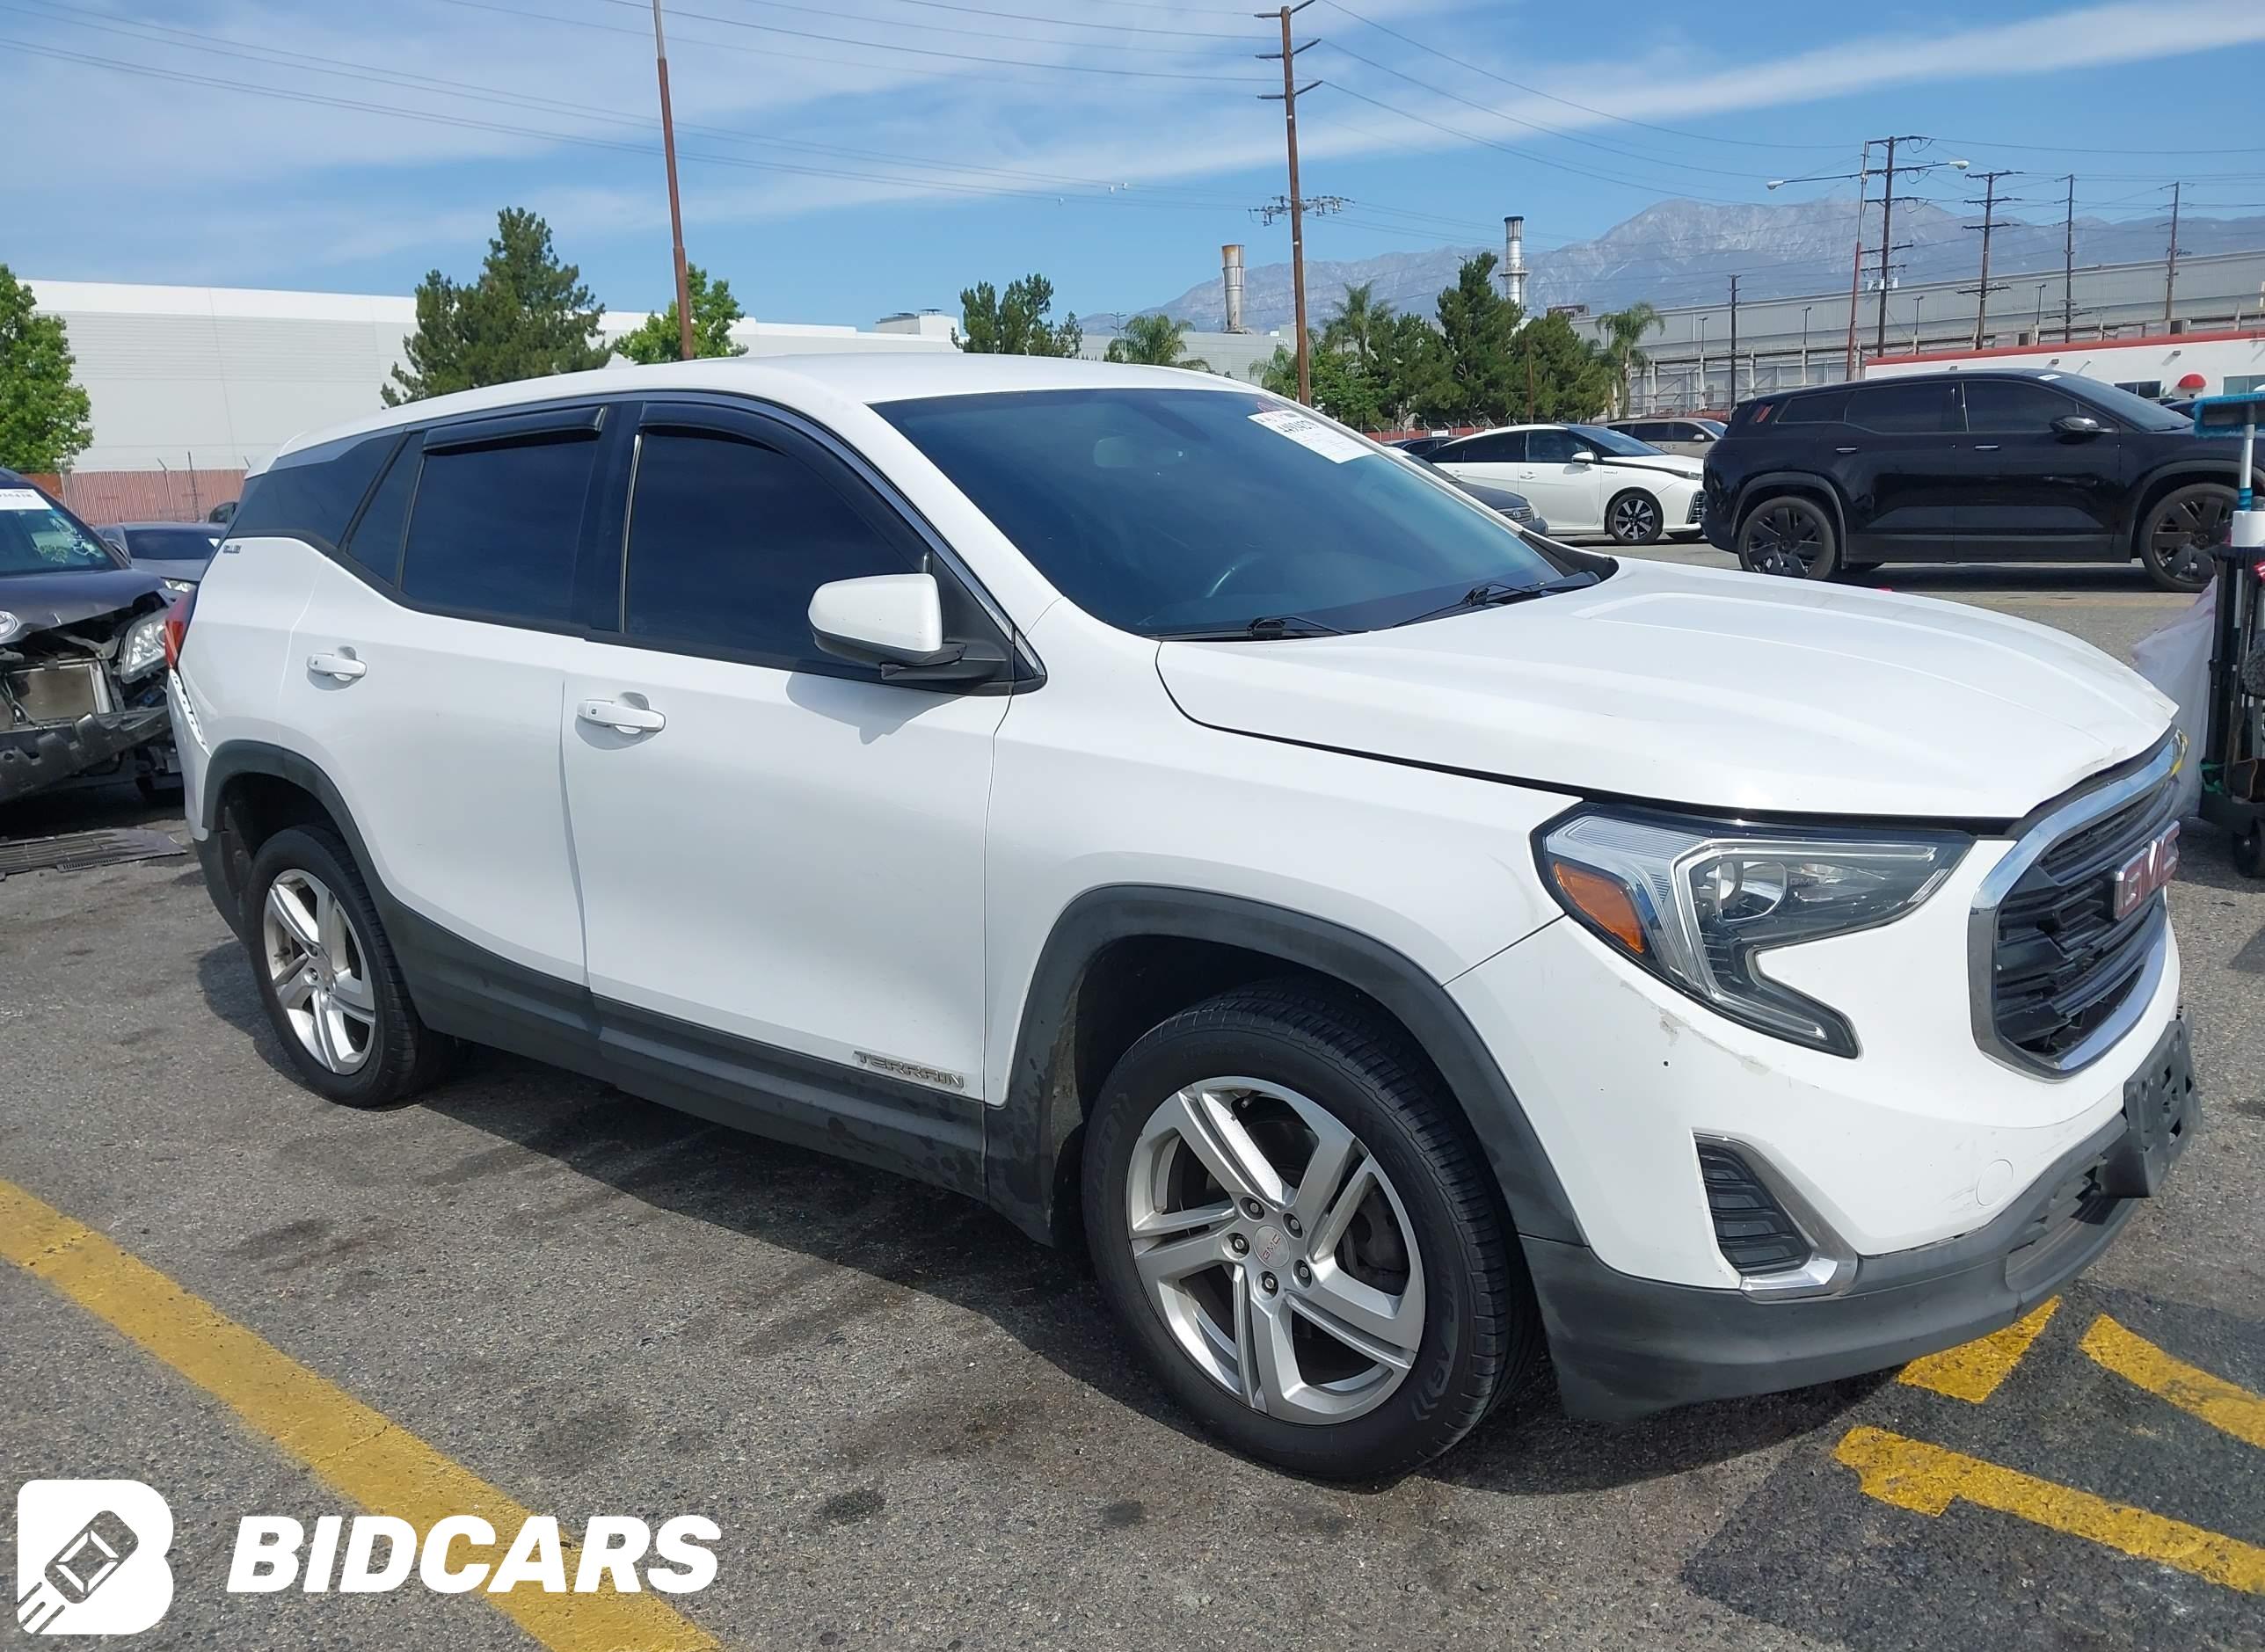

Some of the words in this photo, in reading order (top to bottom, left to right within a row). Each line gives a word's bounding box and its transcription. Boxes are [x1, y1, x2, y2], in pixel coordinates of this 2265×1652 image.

[2114, 819, 2181, 922] GMC
[853, 1050, 965, 1088] TERRAIN
[1262, 1233, 1281, 1260] GMC
